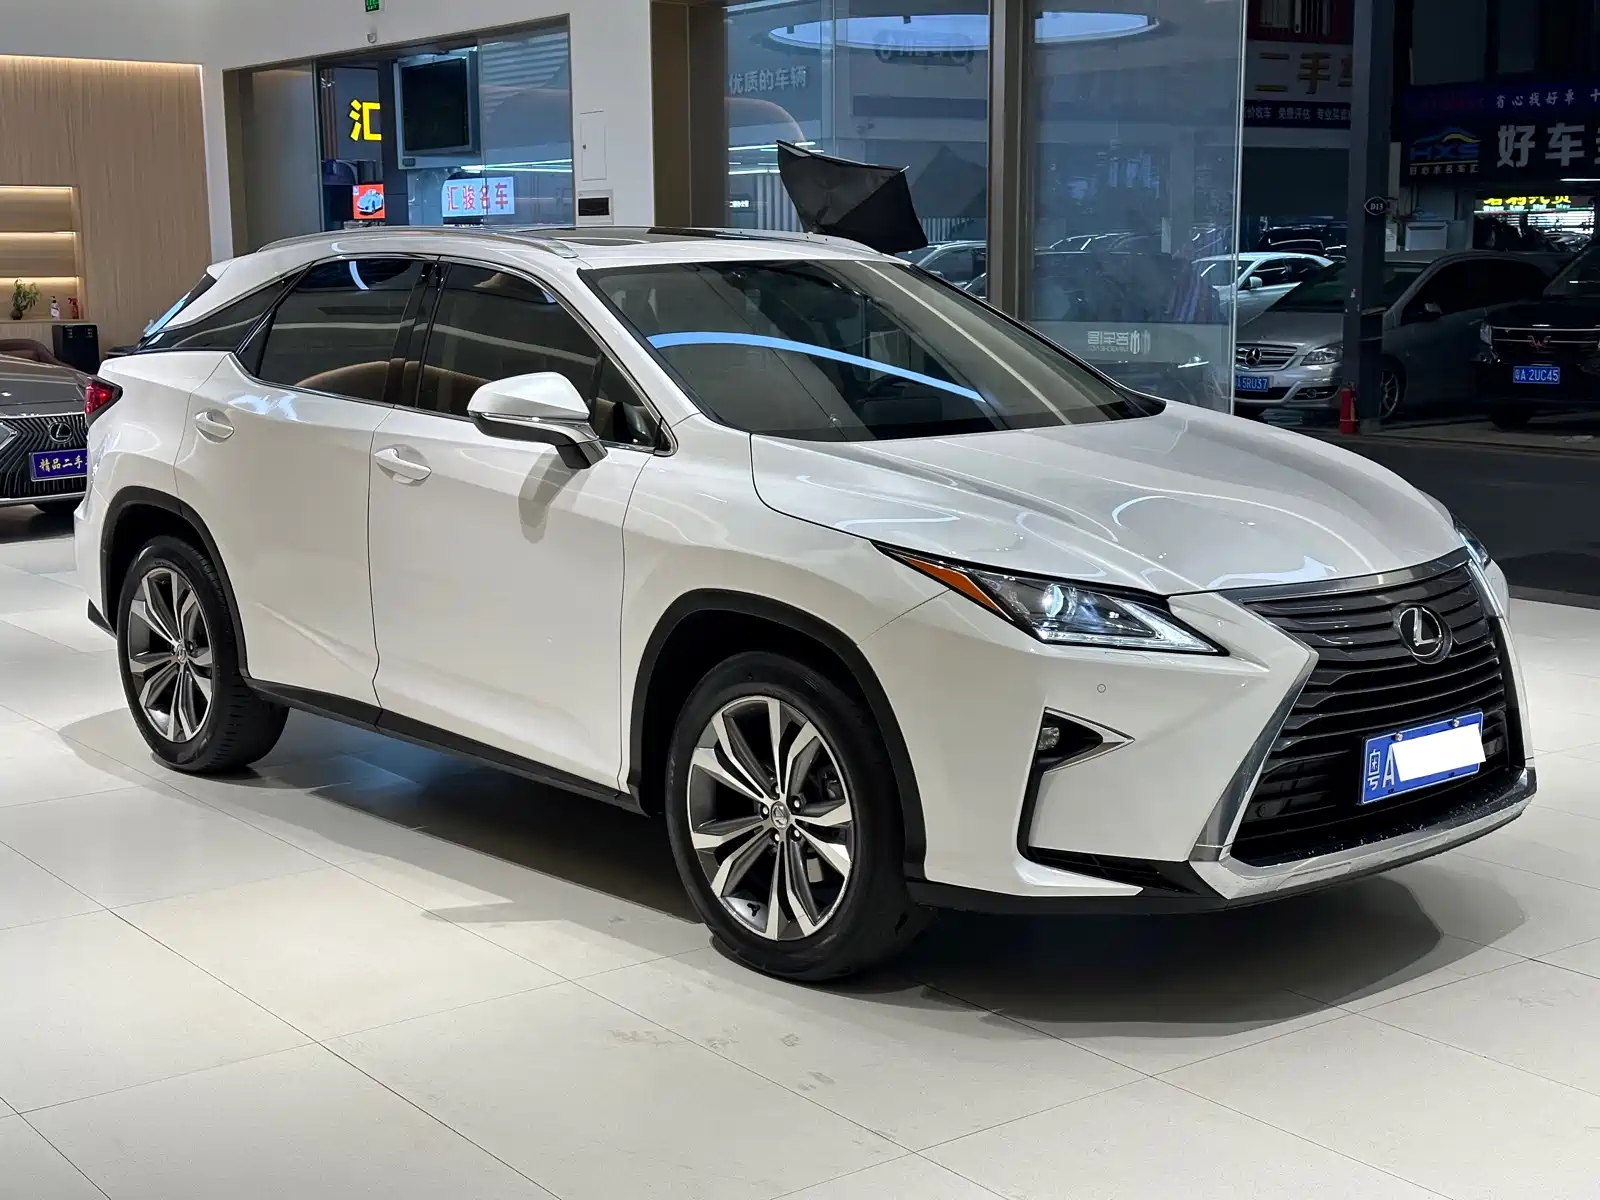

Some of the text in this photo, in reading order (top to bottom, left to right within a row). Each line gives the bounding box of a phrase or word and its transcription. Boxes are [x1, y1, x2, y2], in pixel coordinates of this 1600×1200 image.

[728, 65, 807, 95] 优质的车辆
[349, 99, 382, 141] 汇
[1496, 122, 1600, 168] 好车
[447, 182, 509, 211] 汇骏名车
[1370, 202, 1383, 211] D13
[38, 454, 88, 472] 精品二手
